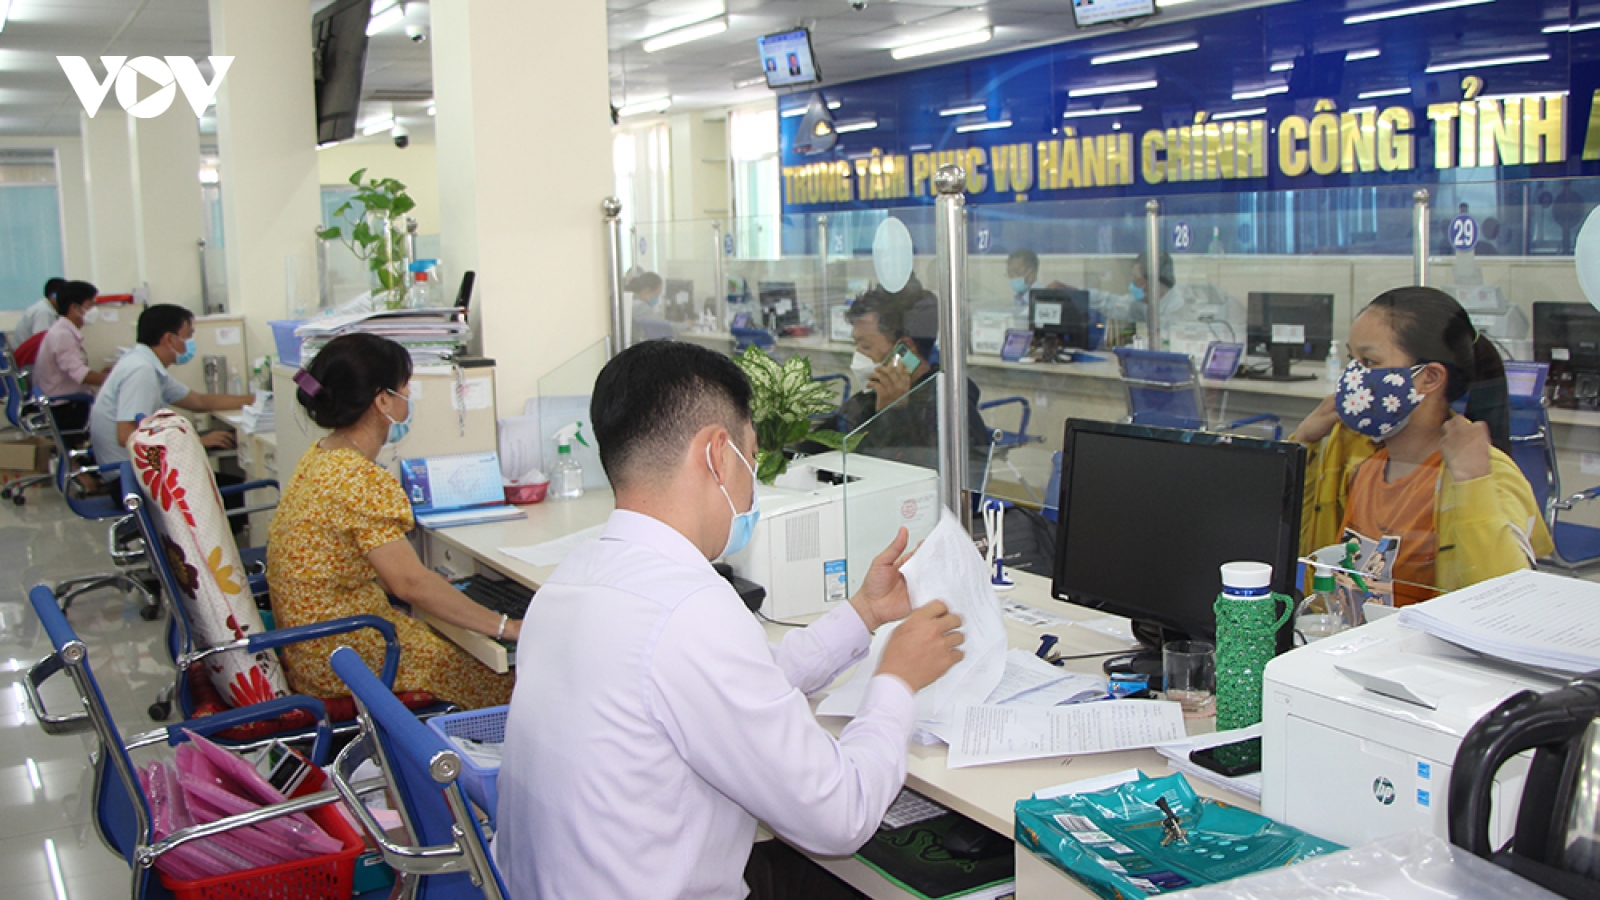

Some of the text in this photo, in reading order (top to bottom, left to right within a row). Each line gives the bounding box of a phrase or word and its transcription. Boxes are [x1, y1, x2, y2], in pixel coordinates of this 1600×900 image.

[783, 160, 853, 204] TRUNG
[856, 147, 909, 200] TÂM
[991, 143, 1034, 203] VỤ
[1037, 126, 1134, 190] HÀNH
[1142, 111, 1268, 184] CHÍNH
[1279, 98, 1415, 177] CÔNG
[1427, 76, 1567, 168] TỈNH
[978, 229, 989, 249] 27
[1174, 224, 1190, 248] 28
[1453, 218, 1474, 246] 29
[1372, 775, 1396, 806] hp
